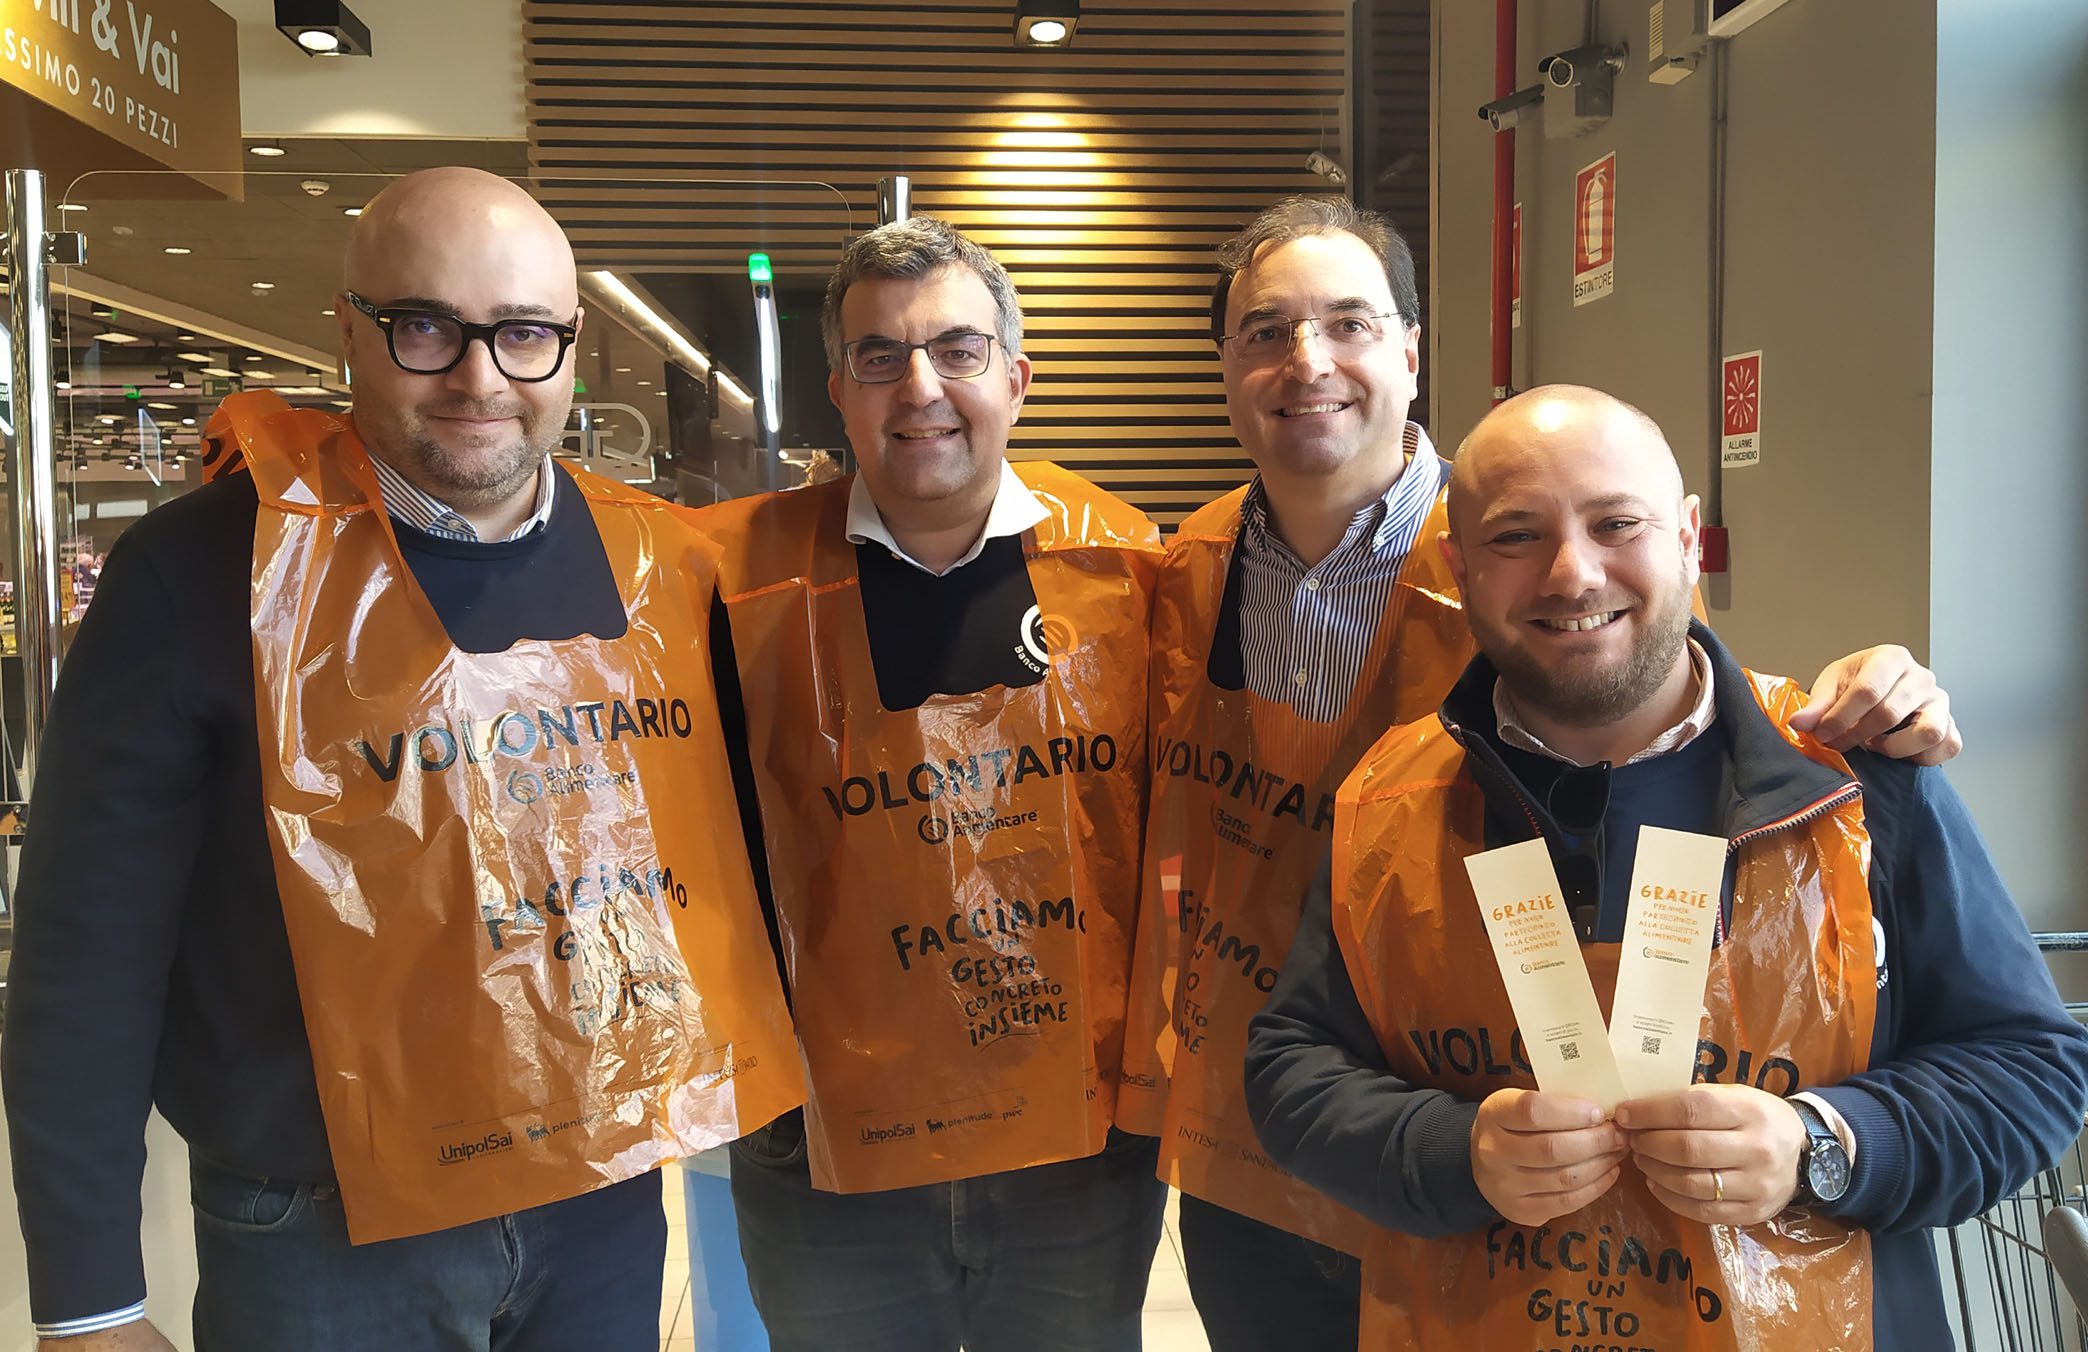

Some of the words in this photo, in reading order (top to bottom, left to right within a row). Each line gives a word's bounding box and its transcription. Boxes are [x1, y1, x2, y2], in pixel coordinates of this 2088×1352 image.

[127, 1, 179, 94] Vai
[0, 28, 80, 96] SSIMO
[91, 77, 115, 115] 20
[126, 97, 178, 149] PEZZI
[1575, 271, 1613, 298] ESTINTORE
[1724, 450, 1758, 462] ANTINCENDIO
[1728, 438, 1753, 450] ALLARME
[1014, 645, 1041, 674] Banco
[359, 698, 692, 783] VOLONTARIO
[544, 763, 594, 781] Banco
[951, 955, 1036, 987] GESTO
[965, 976, 1062, 1018] CONCRETO
[860, 1122, 916, 1143] UnipolSai
[948, 1111, 993, 1128] plenitude
[440, 1131, 514, 1161] UnipolSai
[1586, 1278, 1626, 1299] UN
[1526, 1288, 1640, 1338] GESTO
